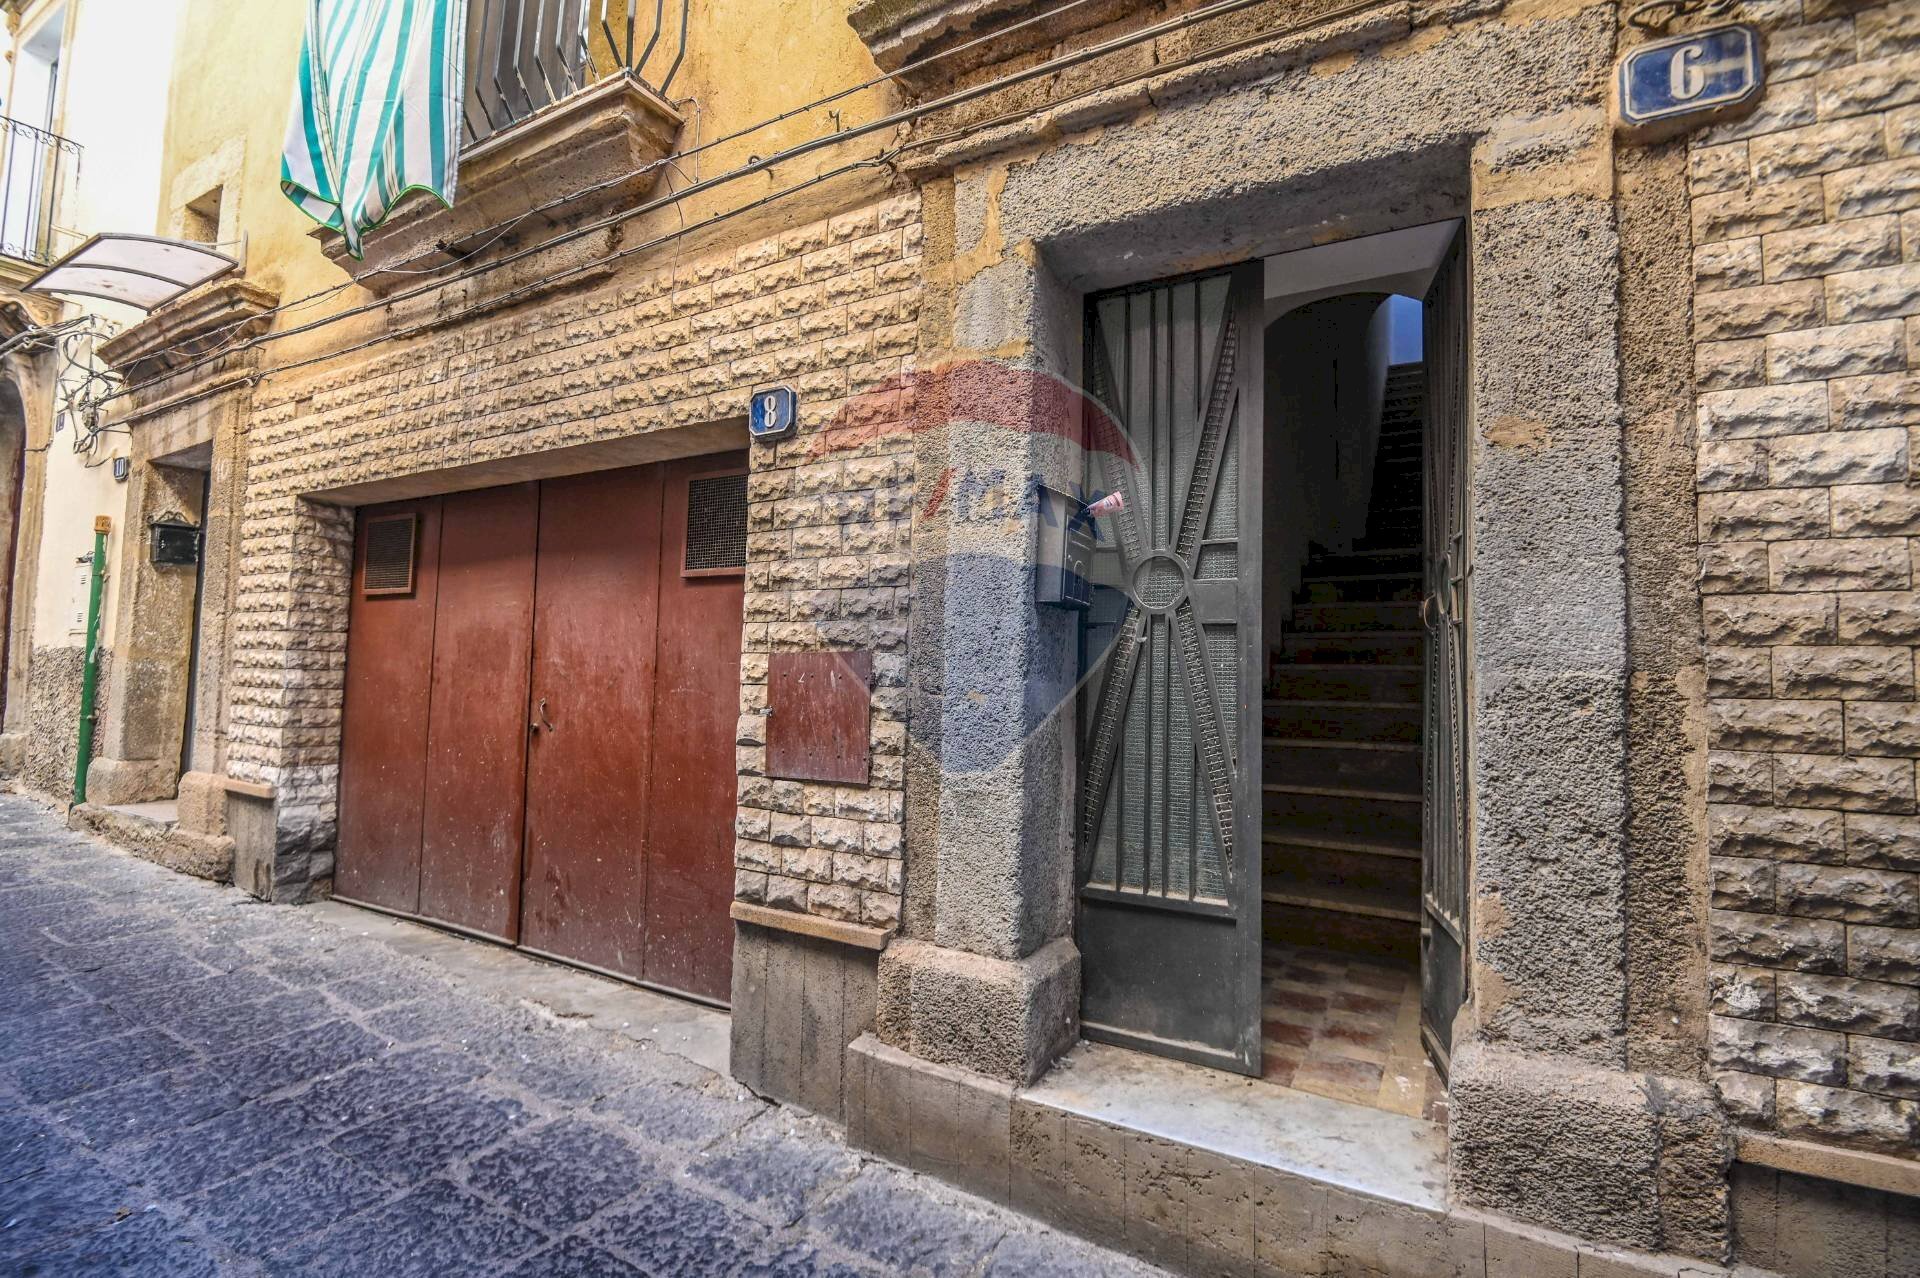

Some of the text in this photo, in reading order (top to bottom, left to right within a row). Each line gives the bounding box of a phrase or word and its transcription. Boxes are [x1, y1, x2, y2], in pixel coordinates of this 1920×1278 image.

[1670, 45, 1705, 100] 6
[764, 395, 777, 428] 8
[116, 458, 124, 476] 10
